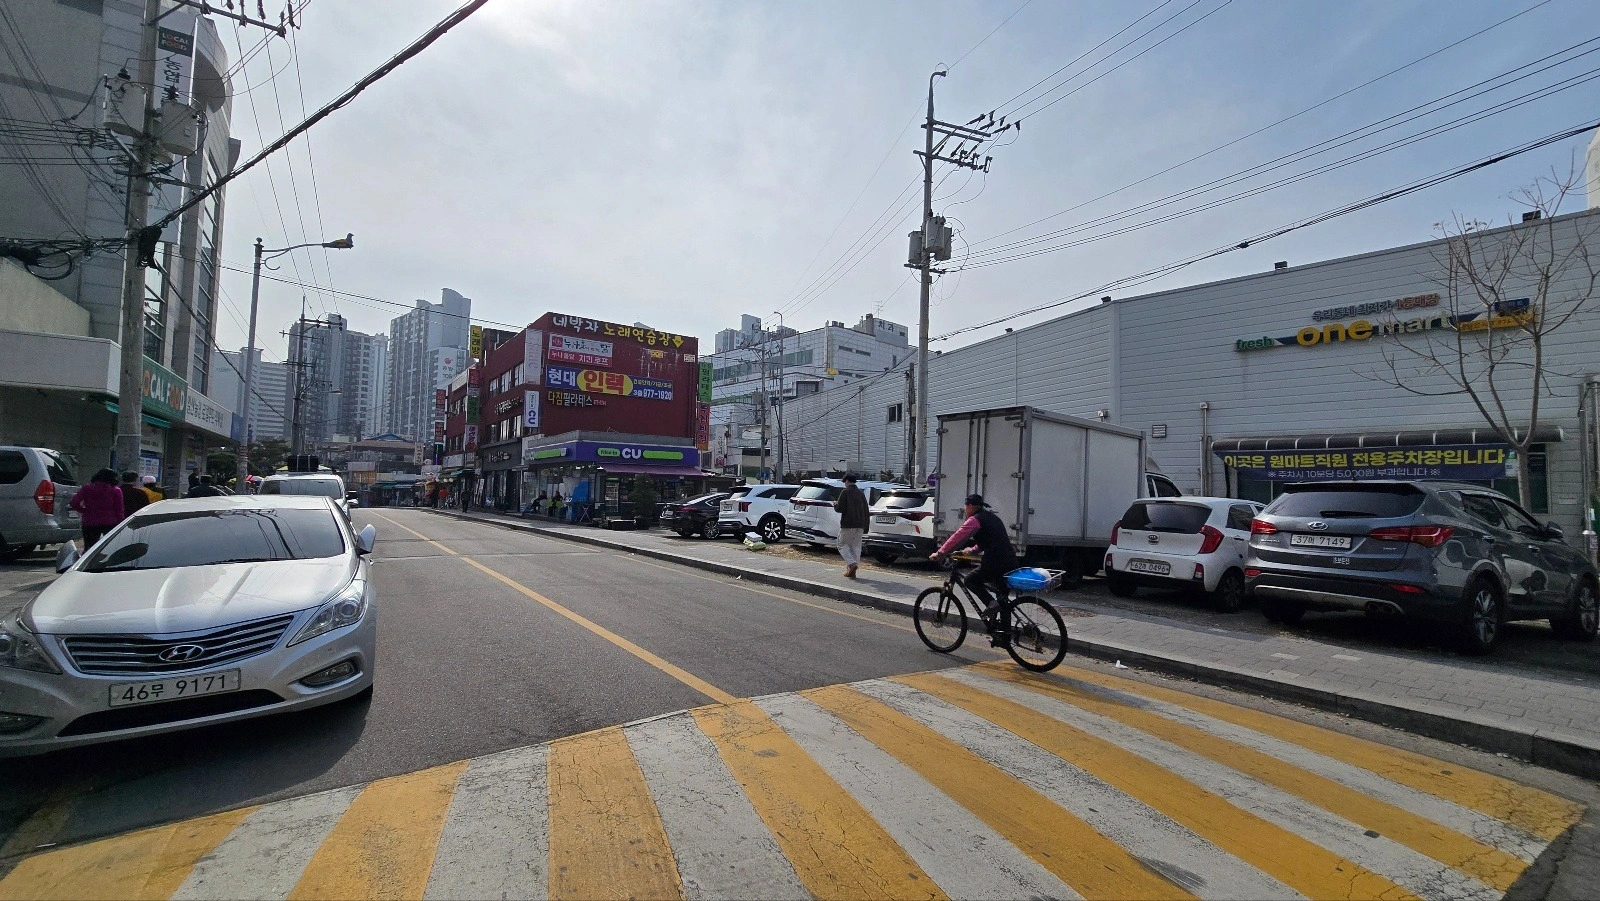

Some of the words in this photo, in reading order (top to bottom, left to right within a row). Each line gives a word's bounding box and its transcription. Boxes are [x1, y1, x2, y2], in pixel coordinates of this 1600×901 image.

[162, 33, 188, 45] LOCAL
[162, 40, 187, 51] FOOD
[1312, 305, 1356, 322] 우리동네
[552, 315, 599, 332] 네박자
[603, 322, 671, 346] 노래연습장
[878, 320, 895, 332] 치과
[1236, 335, 1274, 351] fresh
[1296, 319, 1373, 346] one
[1378, 310, 1449, 336] mart
[471, 329, 480, 354] 노래방
[548, 368, 576, 387] 현대
[583, 369, 625, 396] 인력
[143, 370, 165, 403] OCAL
[166, 383, 185, 411] FOOD
[643, 388, 673, 400] 977-1920
[528, 410, 536, 425] CU
[621, 447, 642, 459] CU
[1224, 455, 1266, 468] 이곳은
[1269, 453, 1348, 468] 원마트직원
[1352, 449, 1506, 467] 전용주차장입니다
[1278, 470, 1304, 478] 주차시
[1377, 467, 1428, 477] 부과합니다
[1319, 536, 1345, 547] 7149
[1149, 564, 1166, 573] 0496
[122, 684, 164, 702] 46무
[176, 675, 226, 695] 9171
